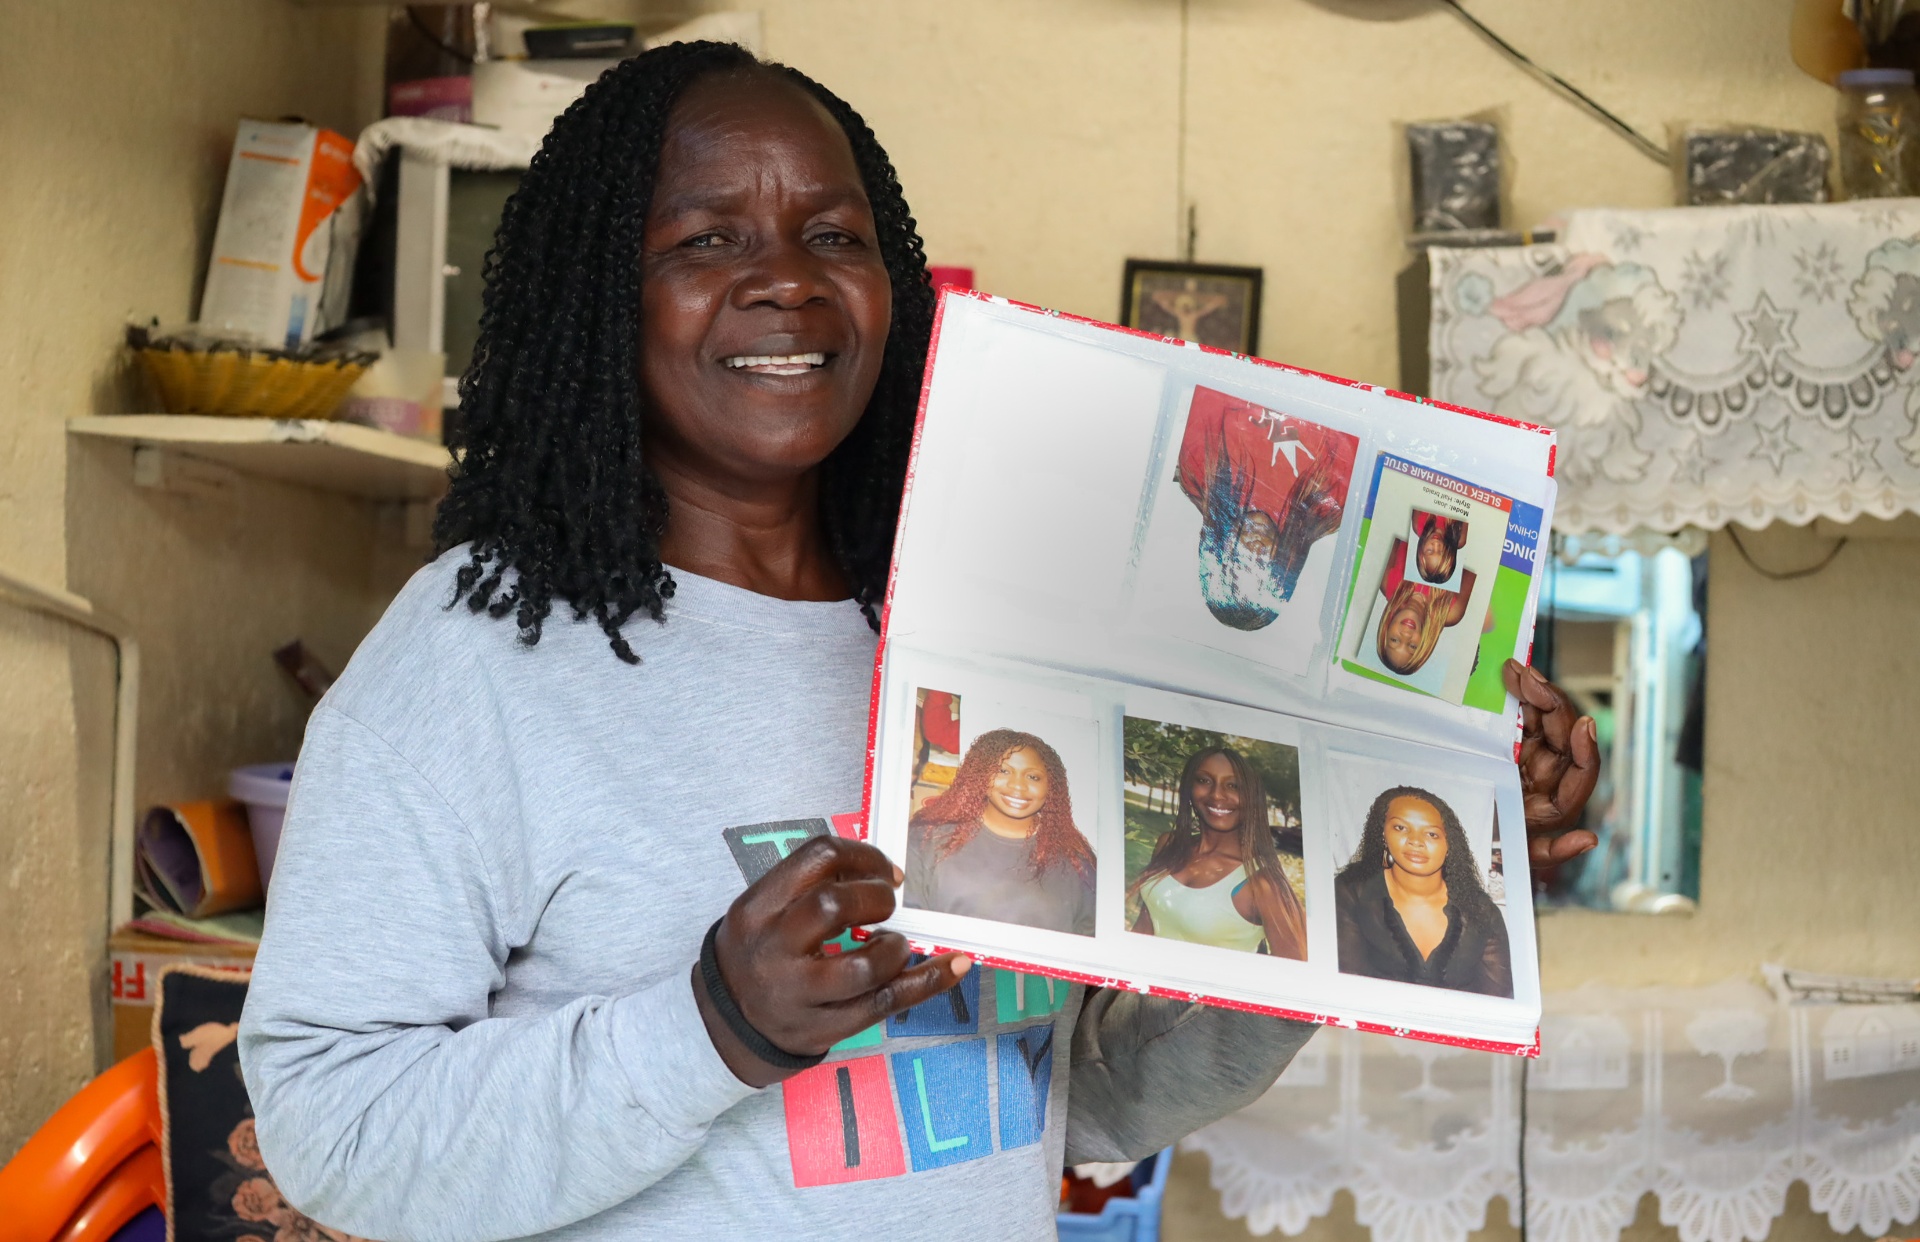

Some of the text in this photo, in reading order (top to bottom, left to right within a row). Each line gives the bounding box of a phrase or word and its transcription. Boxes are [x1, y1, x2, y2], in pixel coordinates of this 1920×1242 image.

[1410, 465, 1434, 482] HAIR
[1436, 477, 1470, 496] TOUCH
[1422, 486, 1471, 509] Style: Half braids
[1471, 487, 1502, 507] SLEEK
[1433, 499, 1469, 517] Model: Joan
[1508, 522, 1538, 540] CHINA
